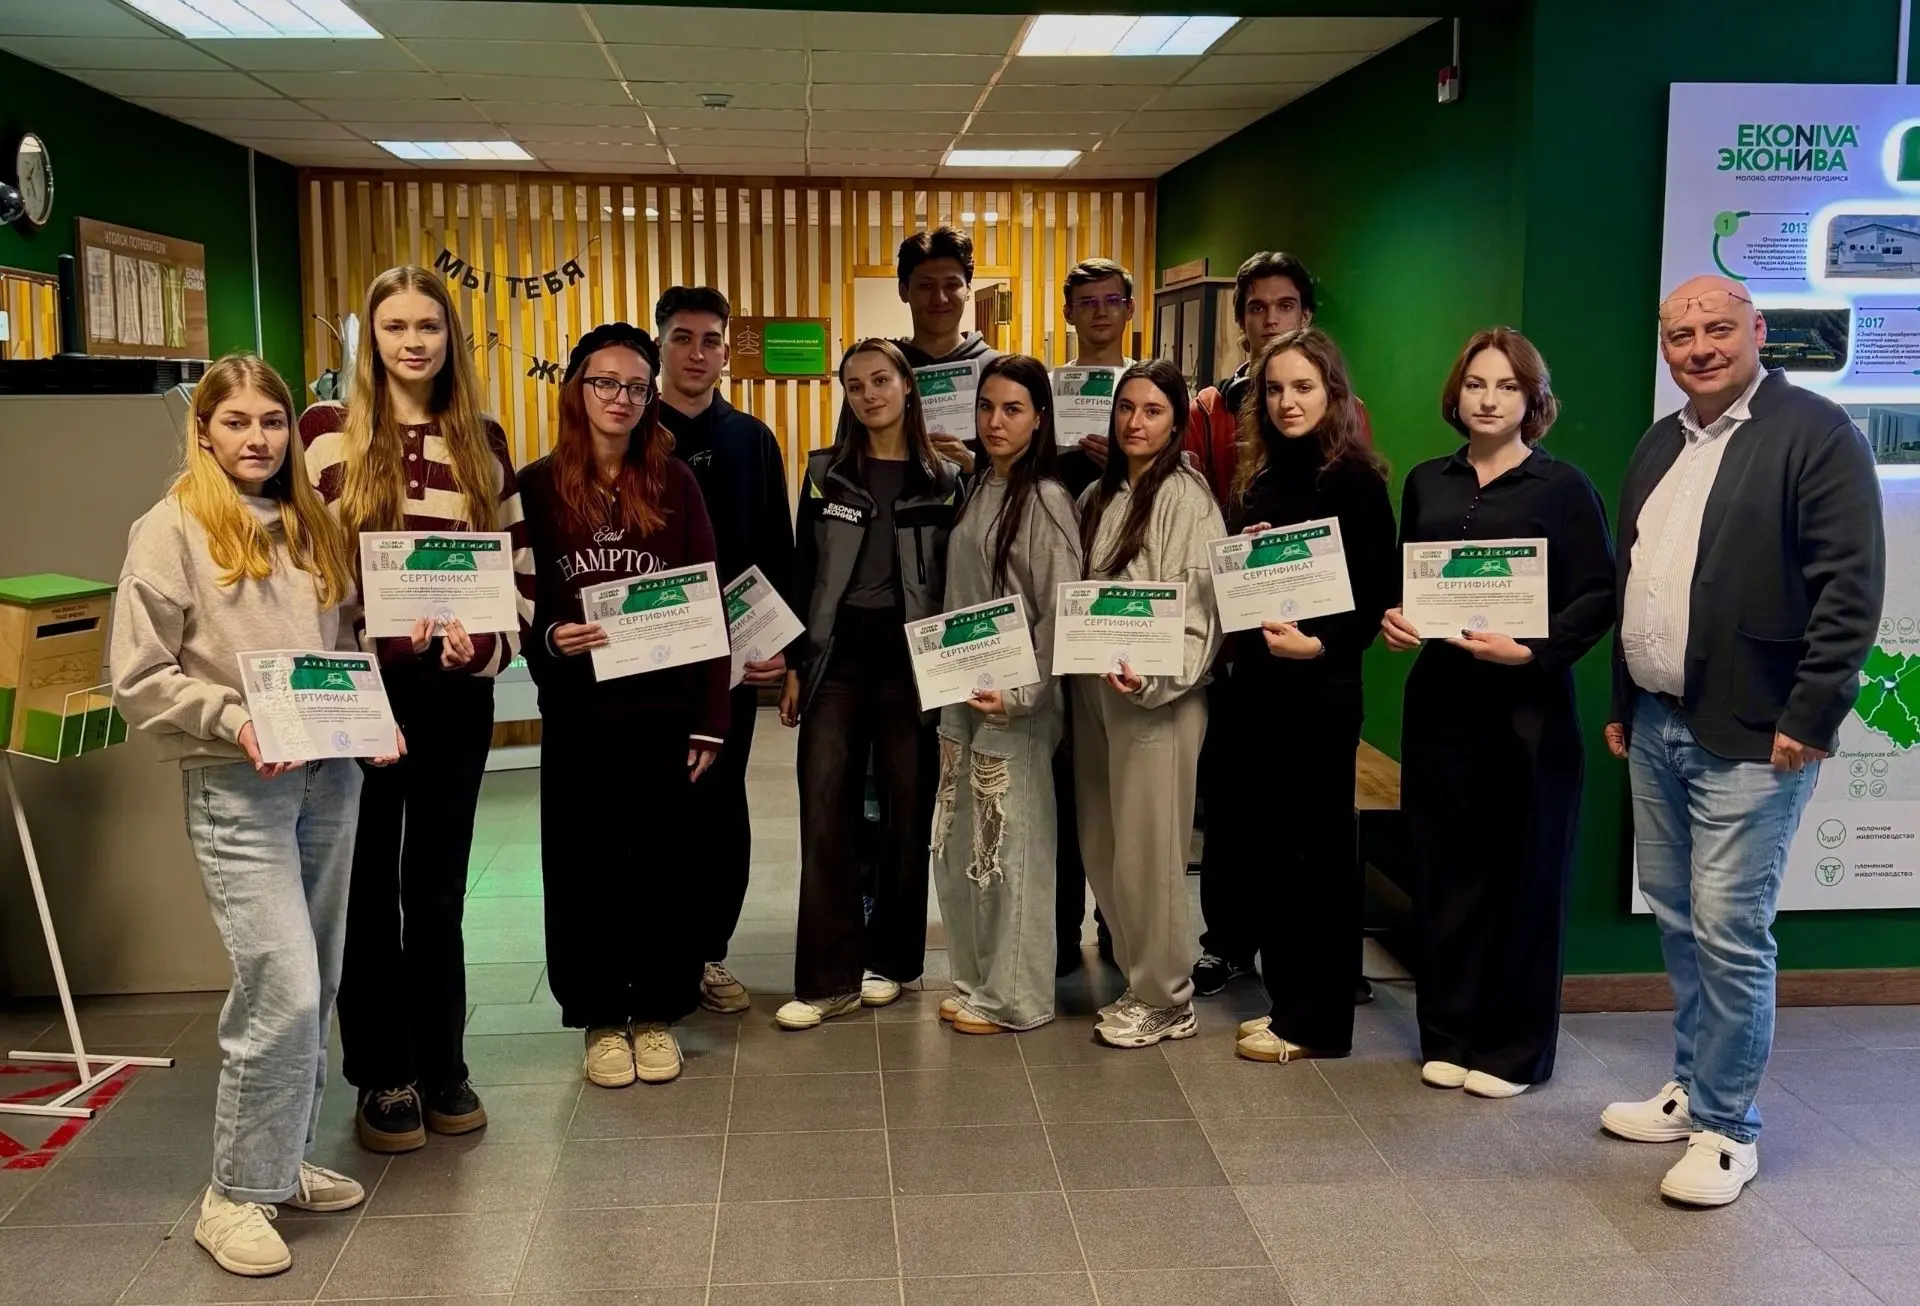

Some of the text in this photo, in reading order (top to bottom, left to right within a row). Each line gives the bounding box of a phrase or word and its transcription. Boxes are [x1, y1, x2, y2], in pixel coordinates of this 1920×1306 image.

[1737, 124, 1859, 147] EKONIVA
[1716, 148, 1848, 171] ЭКОНИВА
[1723, 219, 1729, 230] 1
[1780, 222, 1808, 234] 2013
[104, 231, 167, 255] УГОЛОК ПОТРЕБИТЕЛЯ
[433, 248, 585, 299] МЫ ТЕБЯ
[1858, 317, 1885, 328] 2017
[1075, 398, 1112, 406] СЕРТИФ
[821, 507, 858, 524] ЭКОНИВА
[828, 502, 862, 518] EKONIVA
[593, 525, 625, 546] East
[555, 548, 668, 582] HAMPTON
[1243, 560, 1315, 581] СЕРТИФИКАТ
[400, 574, 478, 583] СЕРТИФИКАТ
[1437, 580, 1512, 590] СЕРТИФИКАТ
[618, 606, 691, 626] СЕРТИФИКАТ
[1084, 618, 1155, 628] СЕРТИФИКАТ
[940, 637, 1001, 659] СЕРТИФИКАТ
[294, 693, 359, 703] ЕРТИФИКАТ
[1839, 750, 1901, 760] Оренбургская обл.
